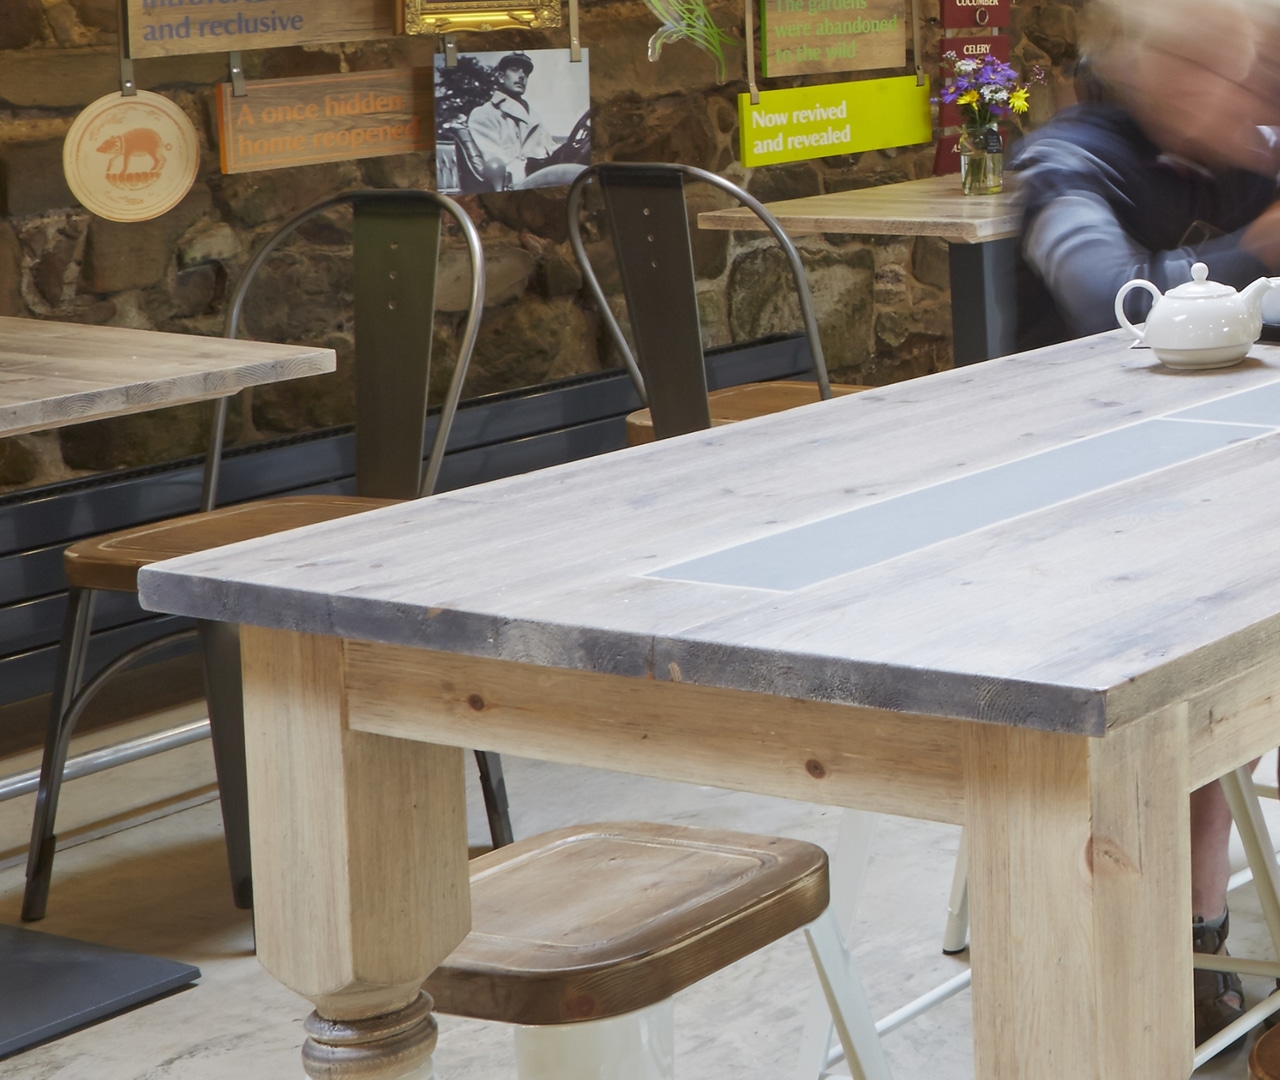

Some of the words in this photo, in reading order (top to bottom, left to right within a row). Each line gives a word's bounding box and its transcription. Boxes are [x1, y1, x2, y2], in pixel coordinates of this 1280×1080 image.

[143, 16, 190, 41] and
[199, 10, 304, 37] reclusive
[775, 22, 812, 38] were
[816, 14, 897, 36] abandoned
[775, 46, 792, 63] to
[796, 42, 820, 62] the
[825, 40, 856, 59] wild
[963, 44, 991, 55] CELERY
[236, 104, 255, 126] A
[261, 101, 318, 123] once
[325, 91, 404, 117] hidden
[752, 110, 788, 129] Now
[792, 100, 847, 124] revived
[238, 131, 307, 158] home
[313, 115, 420, 151] reopened
[753, 132, 784, 155] and
[788, 124, 851, 150] revealed
